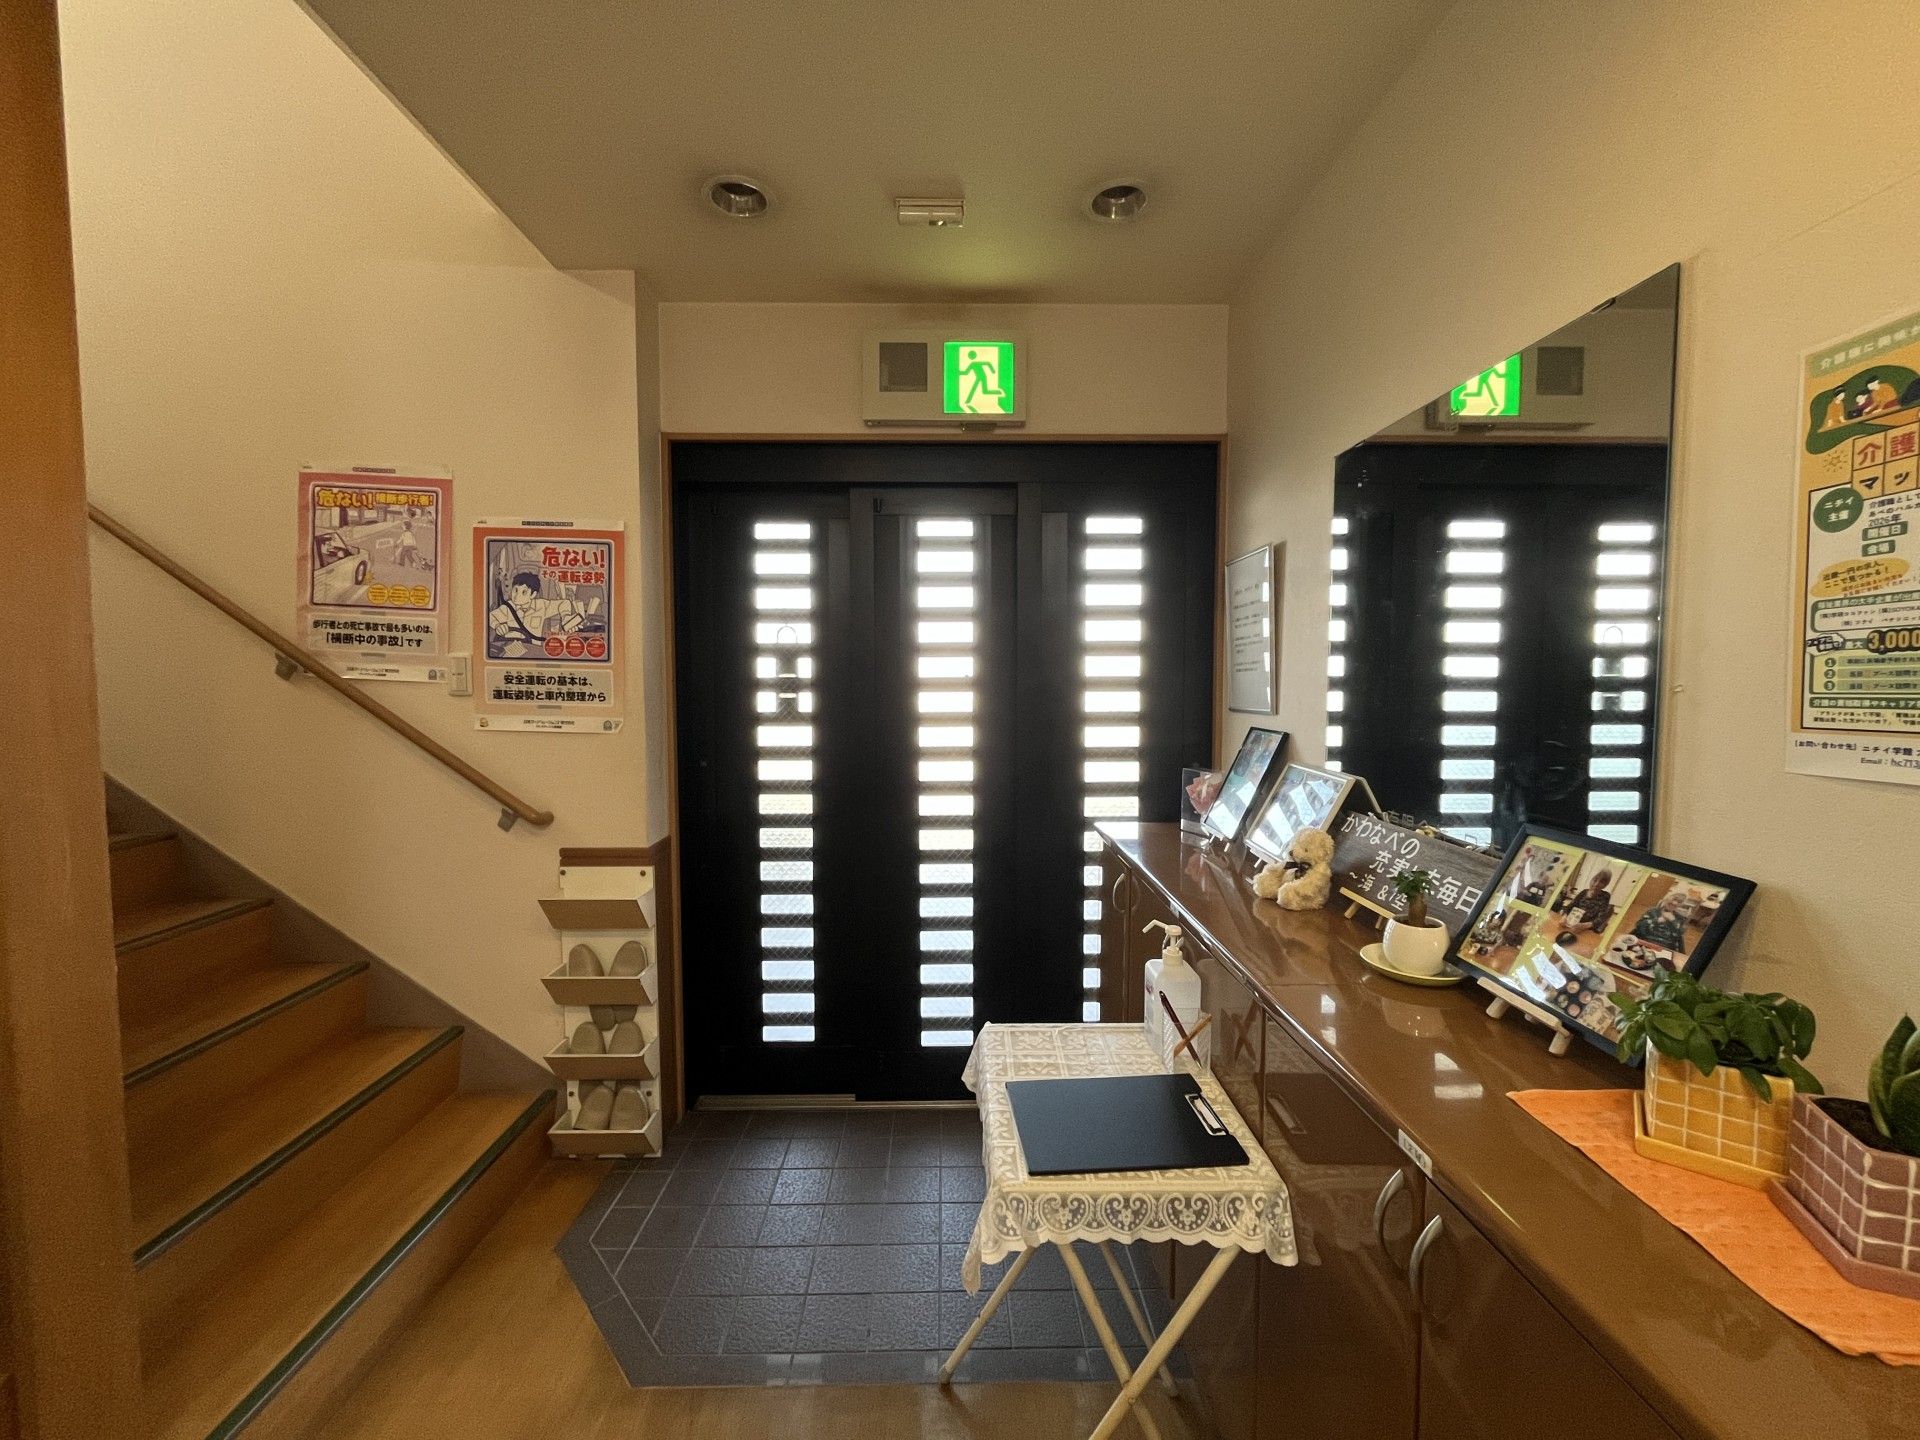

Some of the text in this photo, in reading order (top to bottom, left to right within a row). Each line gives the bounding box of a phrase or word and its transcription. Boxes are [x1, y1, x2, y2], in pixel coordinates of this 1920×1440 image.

[1857, 430, 1917, 466] 介護
[1823, 496, 1854, 510] ニチイ
[542, 570, 605, 584] その運転姿勢
[492, 689, 606, 702] 運転姿勢と車内整理から
[1369, 850, 1483, 915] 充実た毎日
